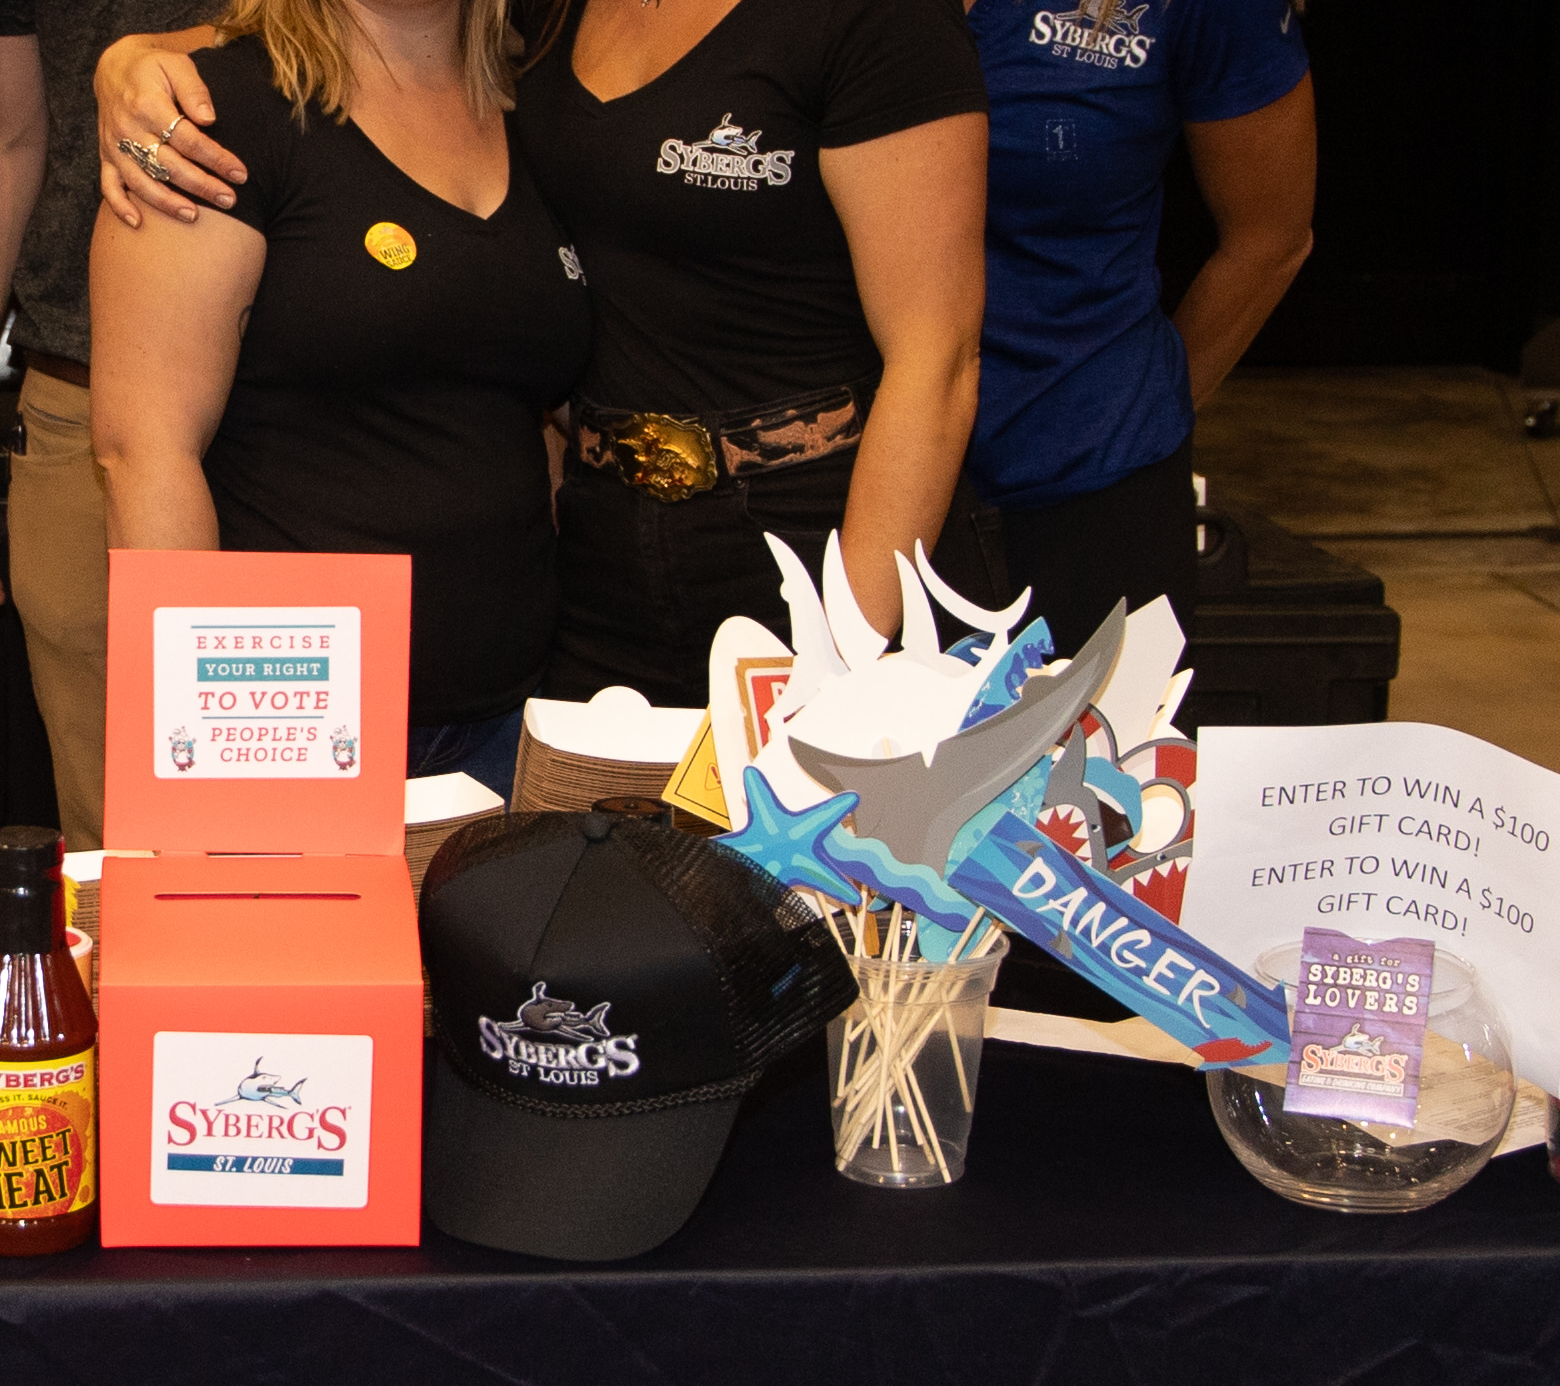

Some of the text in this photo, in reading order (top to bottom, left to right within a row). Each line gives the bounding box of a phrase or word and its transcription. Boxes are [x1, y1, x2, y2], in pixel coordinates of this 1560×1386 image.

[1052, 44, 1118, 70] ST LOUIS
[380, 244, 410, 260] WING
[196, 635, 330, 649] EXERCISE
[205, 663, 321, 676] YOUR RIGHT
[198, 691, 330, 711] TO VOTE
[210, 727, 318, 742] PEOPLE'S
[220, 747, 308, 762] CHOICE
[1261, 775, 1550, 852] ENTER TO WIN A $100
[1329, 814, 1481, 858] GIFT CARD!
[1251, 856, 1534, 934] ENTER TO WIN A $100
[1317, 892, 1468, 937] GIFT CARD!
[1012, 857, 1220, 1029] DANGER
[1333, 953, 1401, 967] a gift for
[1308, 964, 1420, 992] SYBERG'S
[1304, 984, 1418, 1016] LOVERS
[508, 1059, 599, 1085] ST LOUIS
[28, 1094, 58, 1105] SAUCE
[167, 1101, 347, 1151] SYBERG'S
[213, 1156, 294, 1174] ST. LOUIS
